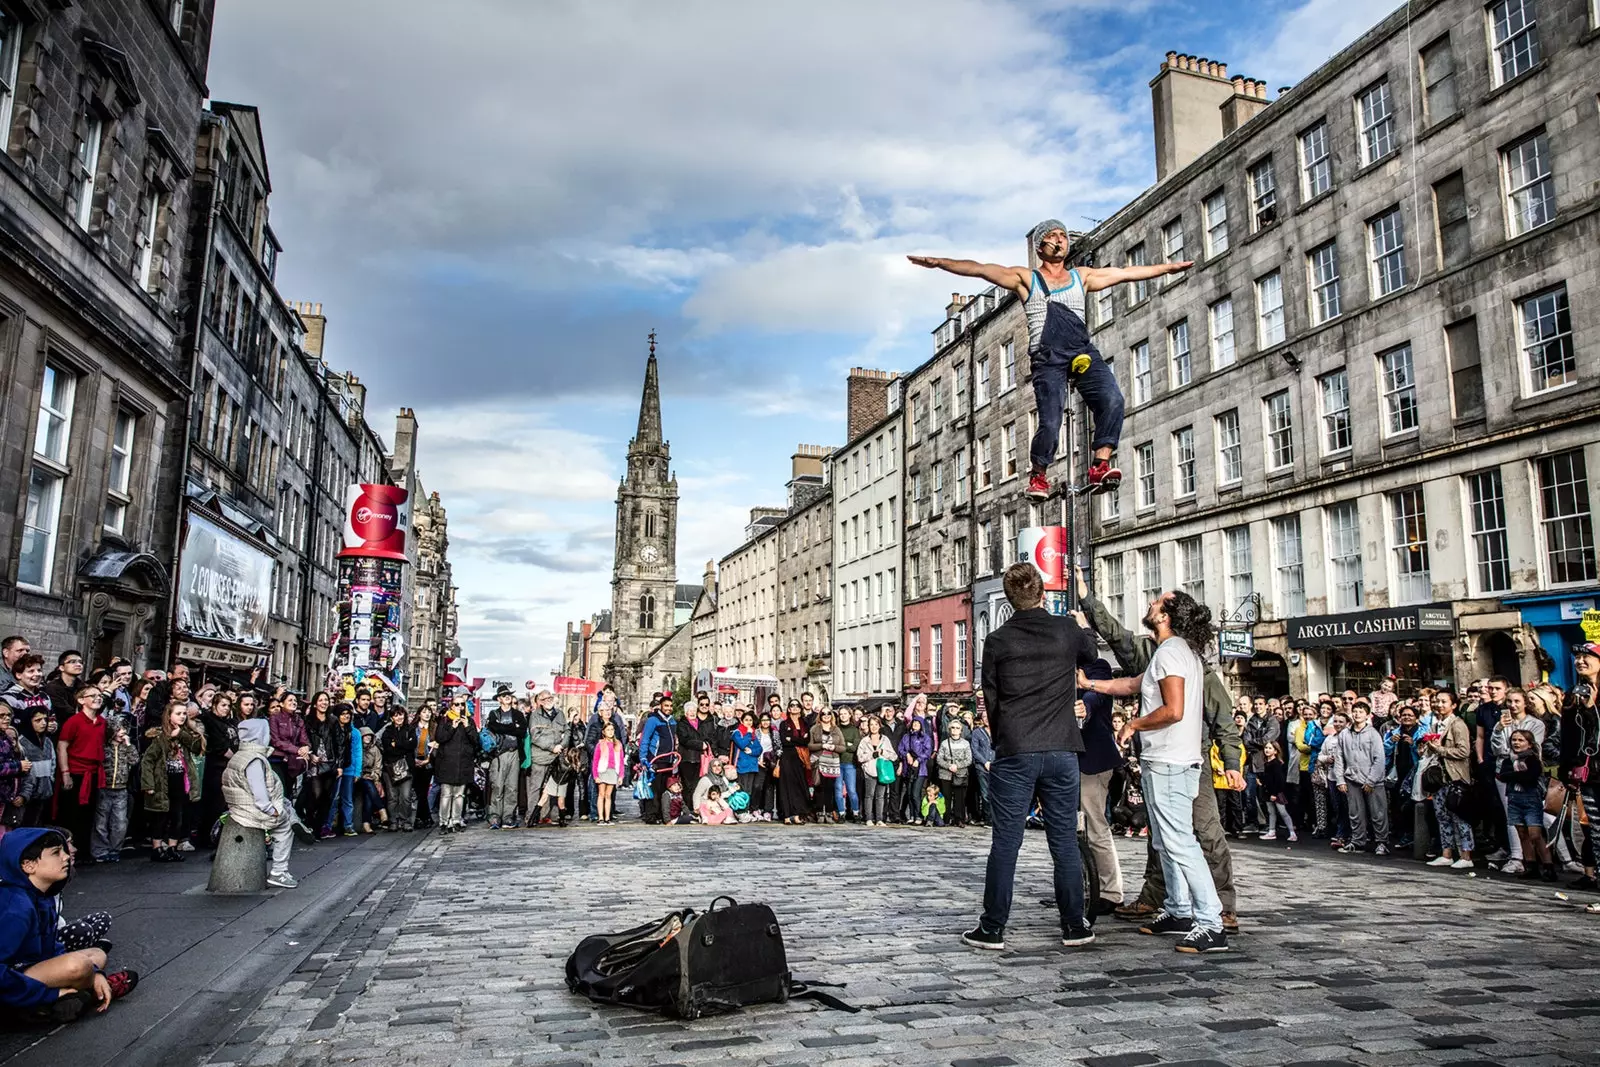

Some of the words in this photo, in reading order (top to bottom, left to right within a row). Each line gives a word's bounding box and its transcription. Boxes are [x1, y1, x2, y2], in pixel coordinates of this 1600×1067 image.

[372, 513, 392, 521] money
[190, 563, 198, 594] 2
[198, 566, 232, 604] COURSES
[1226, 632, 1245, 643] fringe
[1297, 622, 1350, 639] ARGYLL
[192, 647, 204, 658] THE
[207, 649, 228, 661] FILLING
